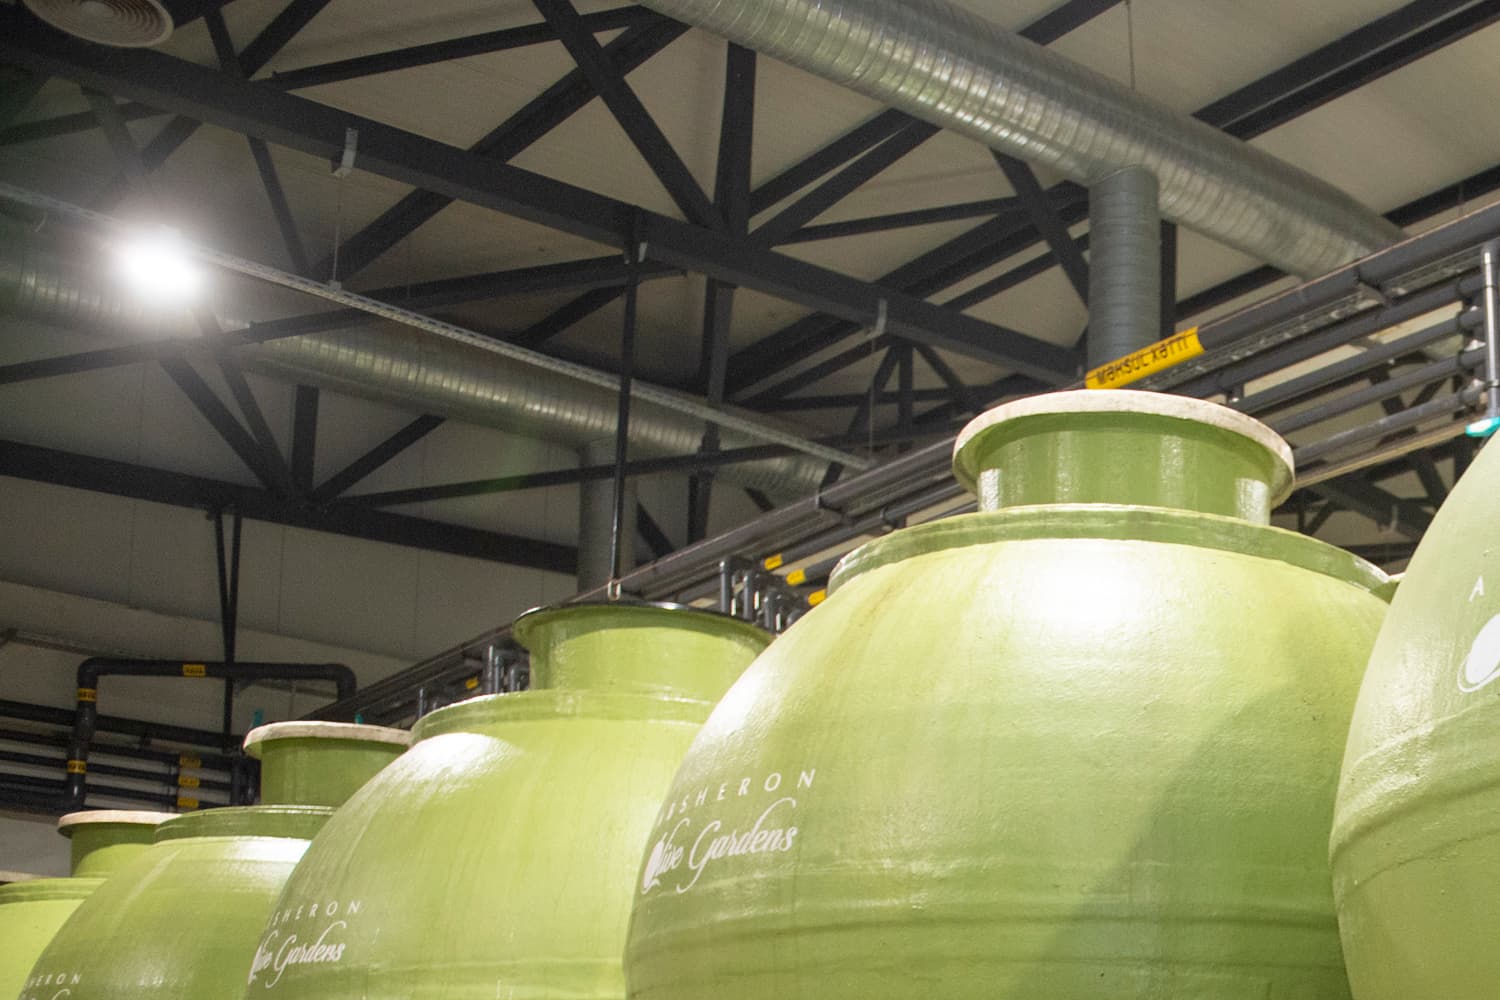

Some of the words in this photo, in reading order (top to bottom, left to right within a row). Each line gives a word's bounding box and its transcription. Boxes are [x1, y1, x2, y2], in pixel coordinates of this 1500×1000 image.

[676, 797, 798, 893] Gardens
[267, 900, 361, 927] SHERON
[265, 920, 347, 988] Gardens
